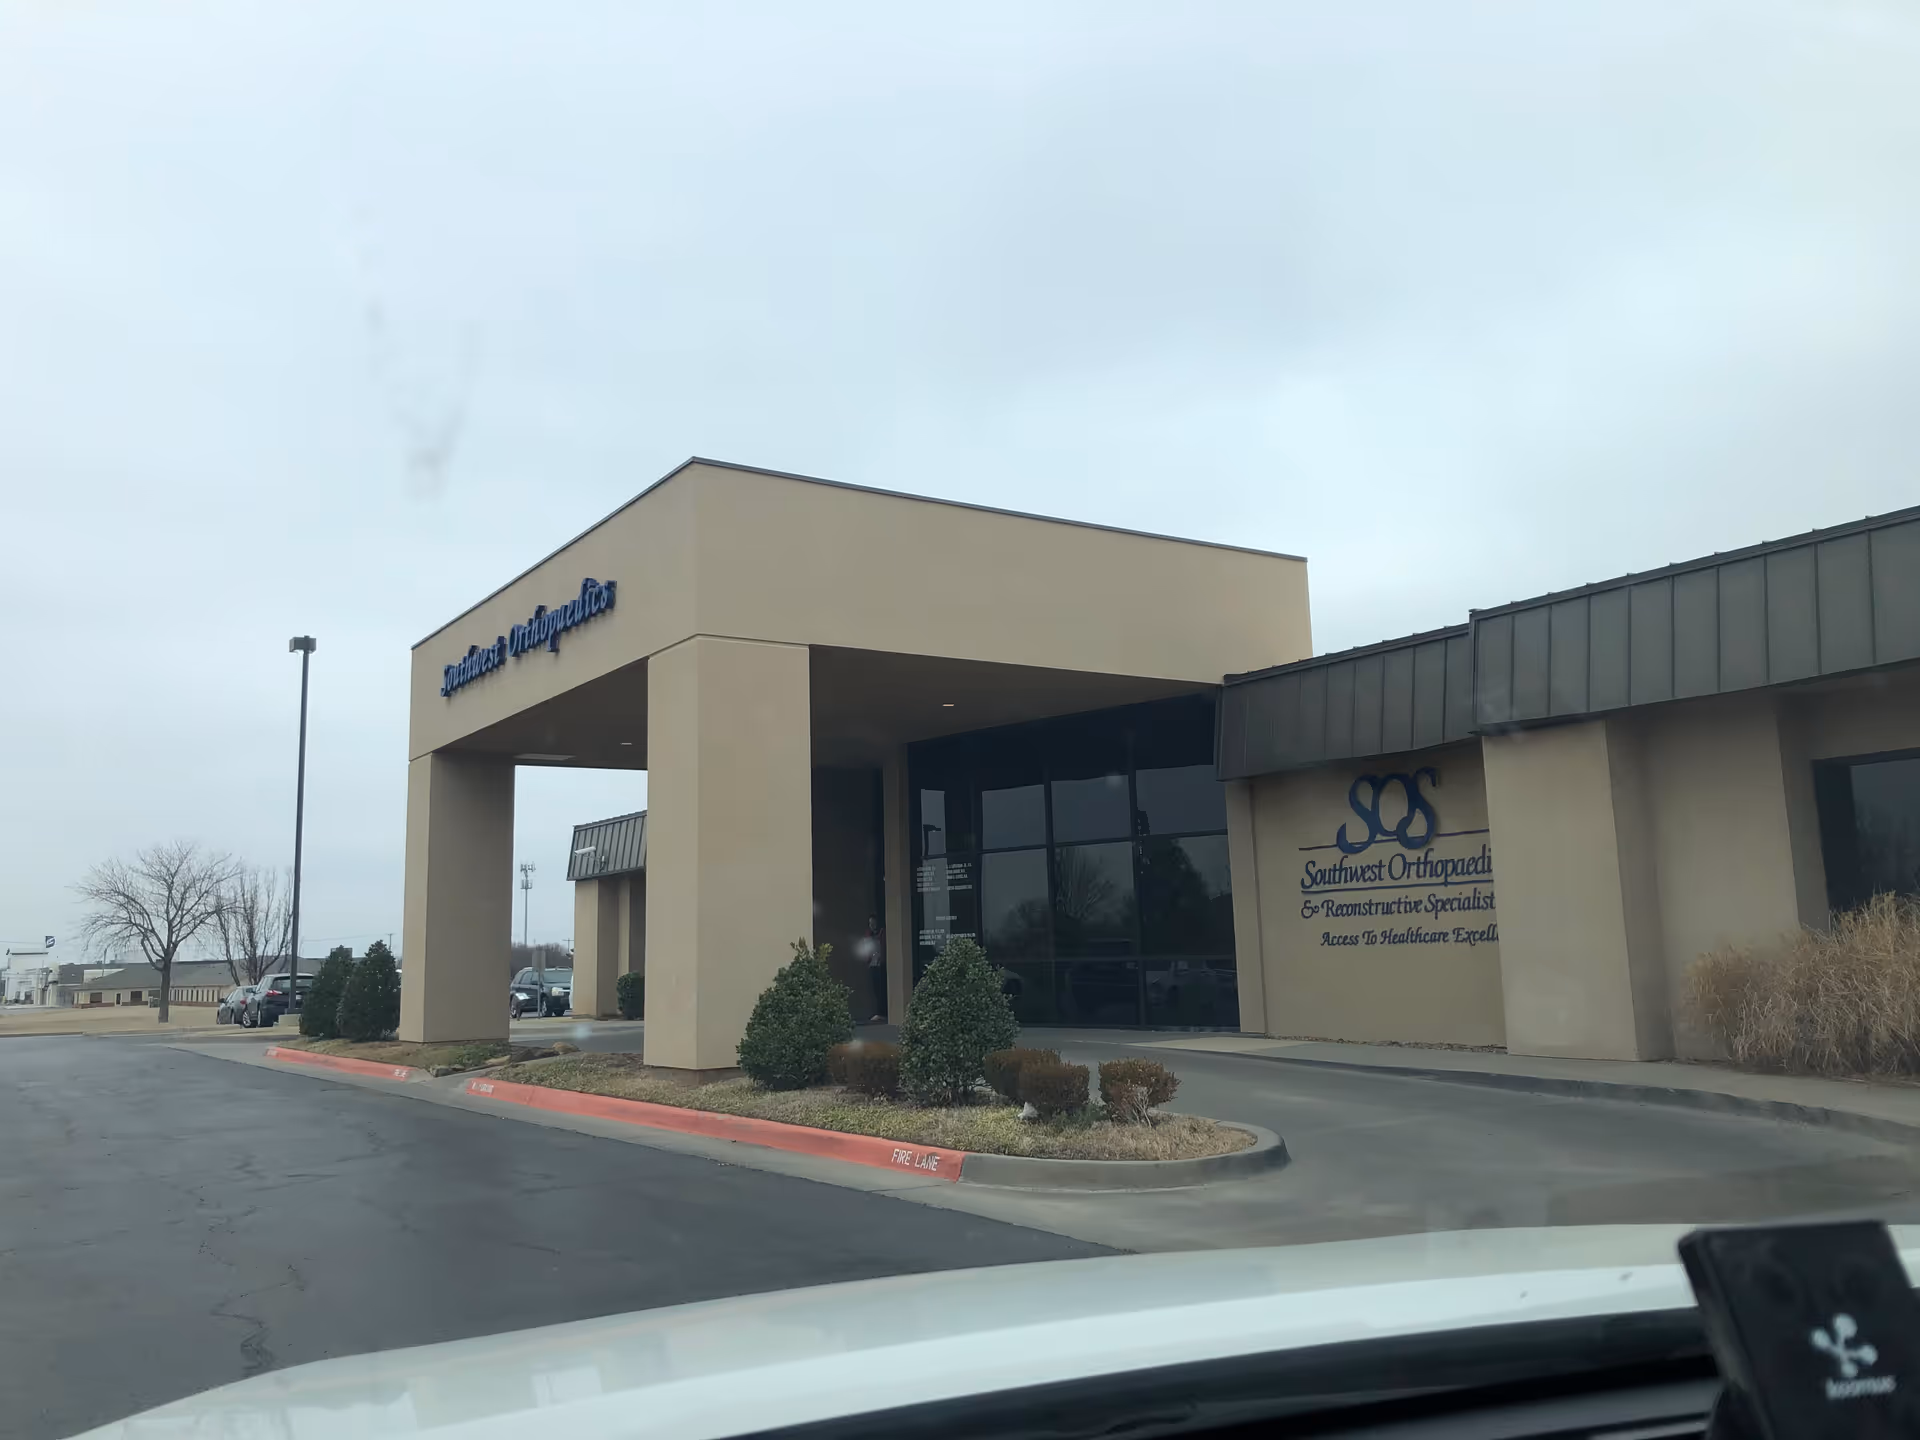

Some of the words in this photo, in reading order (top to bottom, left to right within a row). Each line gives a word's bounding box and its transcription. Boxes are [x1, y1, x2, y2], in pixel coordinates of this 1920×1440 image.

[440, 634, 508, 698] Southwest
[507, 577, 617, 658] Orthopaedics
[1336, 766, 1438, 855] SOS
[1300, 855, 1386, 890] Southwest
[1300, 899, 1320, 919] &
[1321, 895, 1423, 918] Reconstructive
[1424, 887, 1496, 920] Specialist
[1320, 931, 1360, 947] Access
[1362, 930, 1378, 946] To
[1380, 926, 1449, 946] Healthcare
[1452, 923, 1499, 947] Excell
[891, 1148, 912, 1166] FIRE
[914, 1152, 941, 1172] LANE
